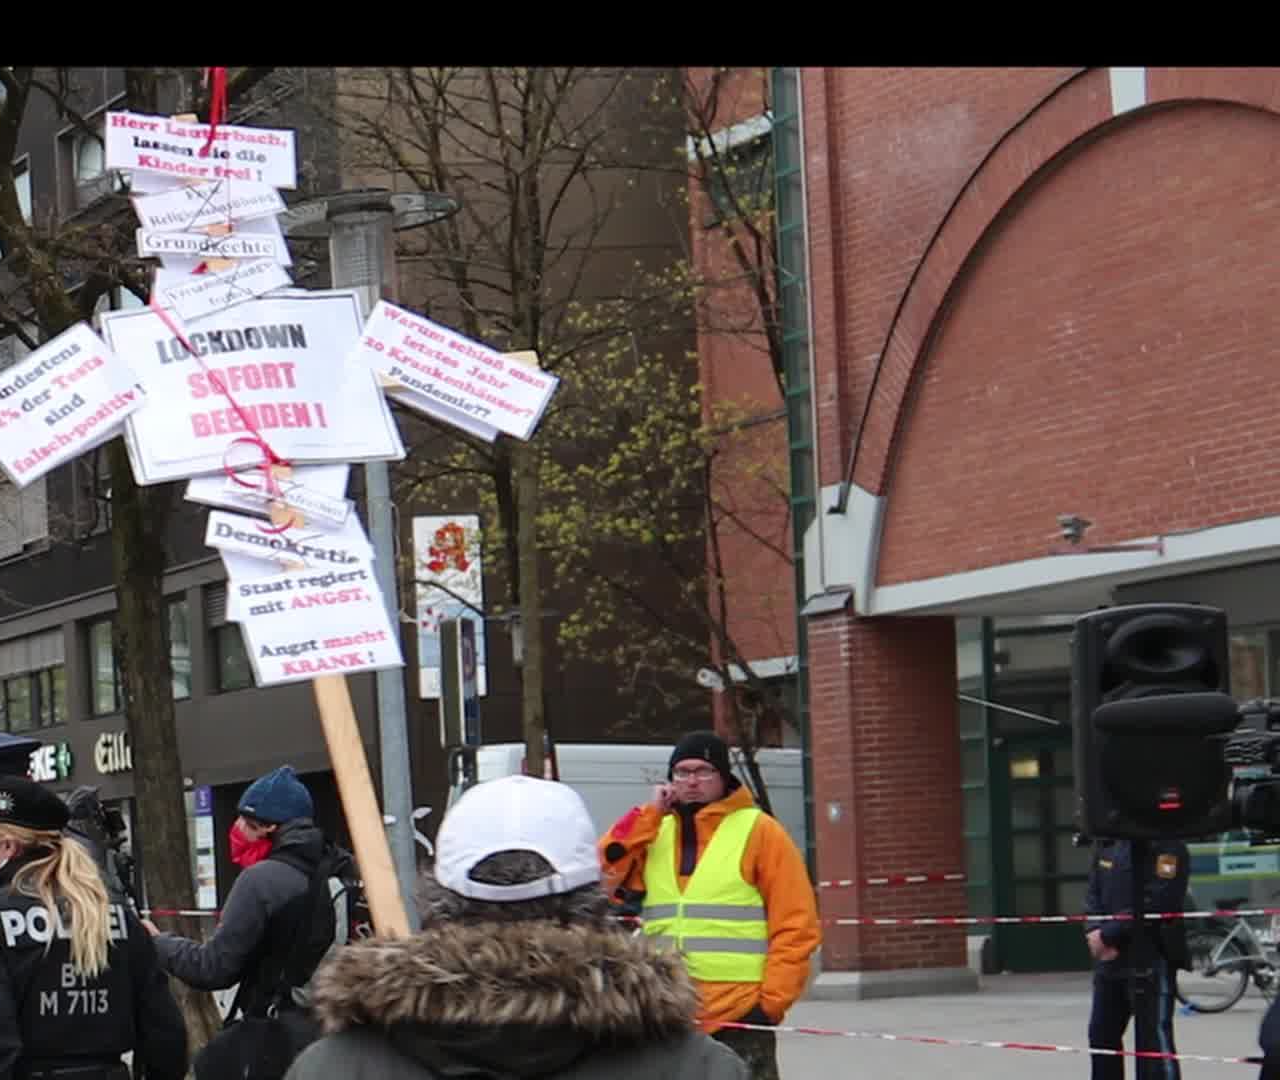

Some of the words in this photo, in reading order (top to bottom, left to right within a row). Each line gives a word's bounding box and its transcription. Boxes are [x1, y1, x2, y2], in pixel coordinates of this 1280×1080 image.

[111, 115, 159, 132] Herr
[133, 136, 193, 156] lassen
[236, 149, 267, 163] die
[137, 154, 208, 176] Kinder
[155, 323, 308, 364] LOCKDOWN
[384, 306, 444, 343] Warum
[509, 367, 546, 390] man
[21, 389, 52, 413] der
[51, 355, 105, 390] Tests
[187, 362, 297, 399] SOFORT
[466, 366, 511, 390] Jahr
[44, 392, 86, 426] sind
[13, 390, 136, 475] falsch-positiv
[239, 577, 297, 598] Staat
[298, 569, 368, 591] regiert
[249, 599, 285, 616] mit
[259, 638, 317, 658] Angst
[322, 630, 387, 650] macht
[282, 651, 365, 676] KRANK
[40, 991, 58, 1016] M
[67, 989, 109, 1014] 7113
